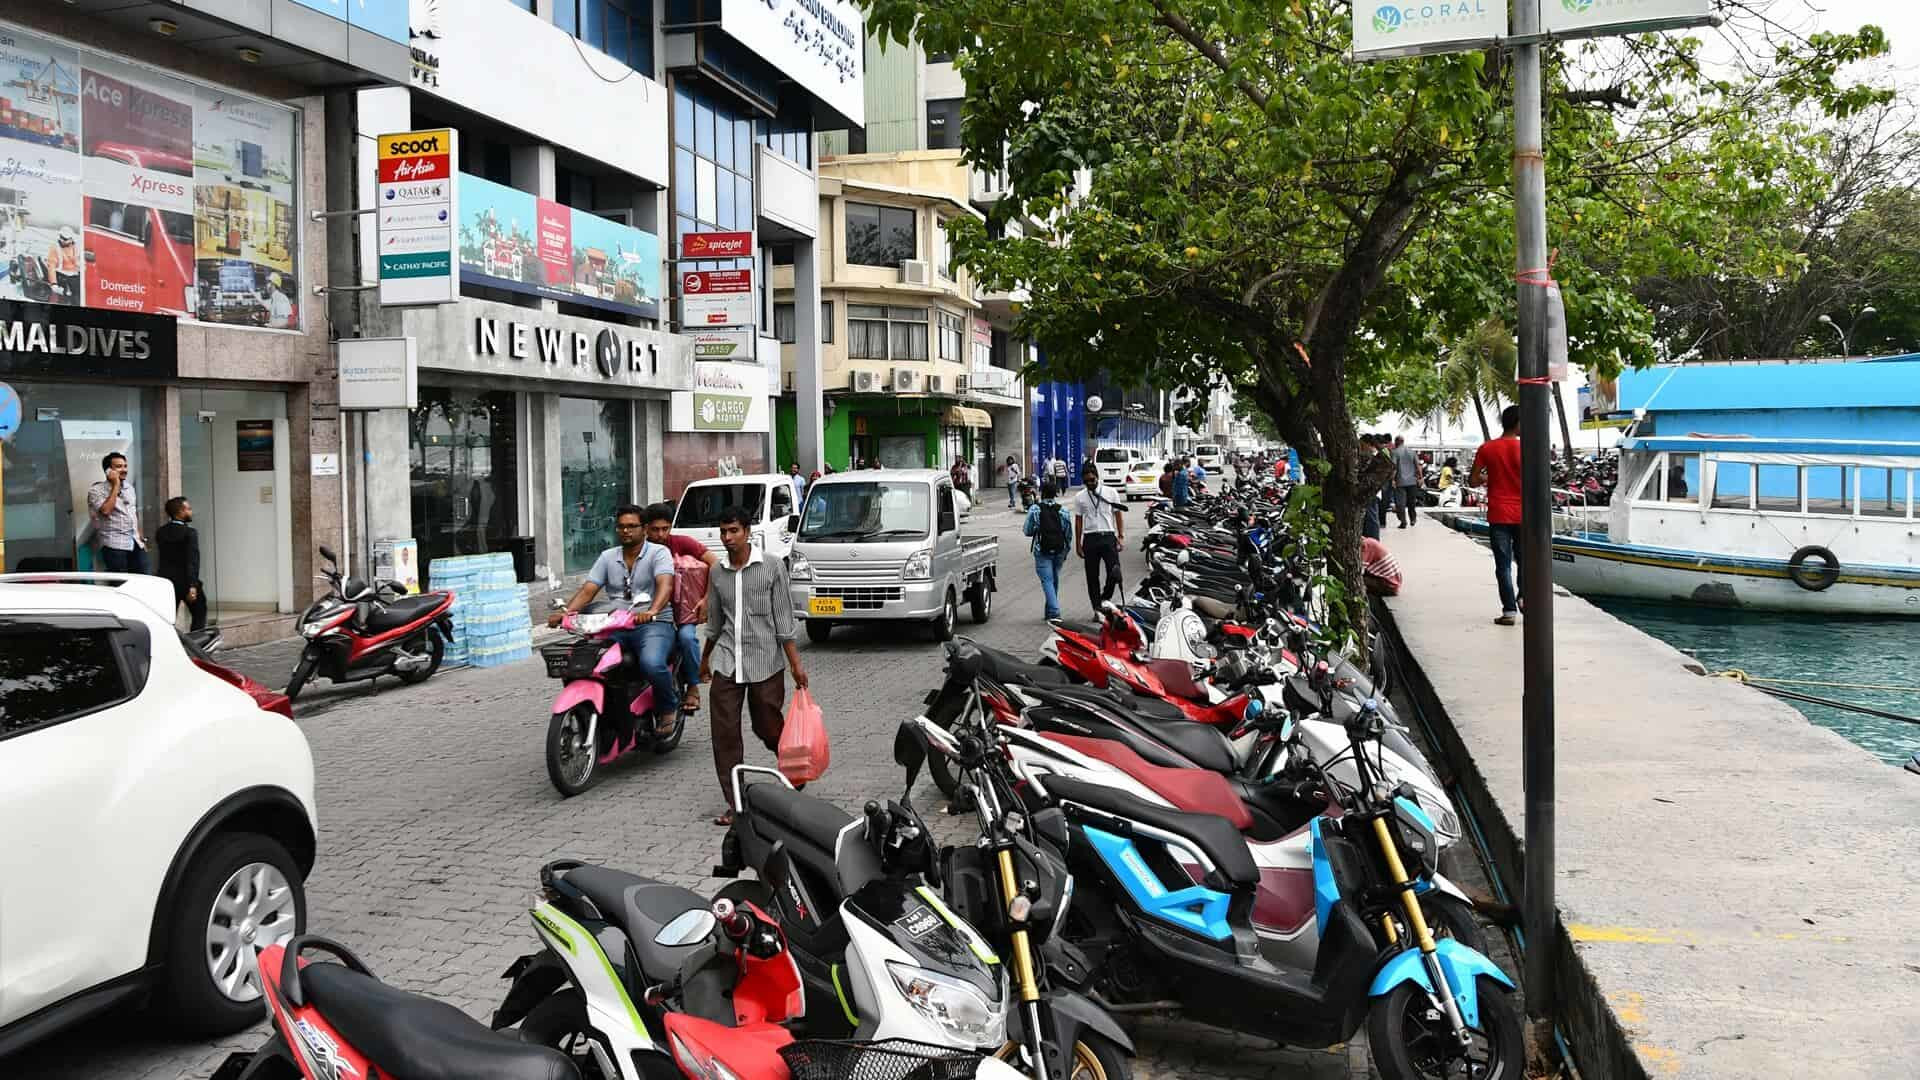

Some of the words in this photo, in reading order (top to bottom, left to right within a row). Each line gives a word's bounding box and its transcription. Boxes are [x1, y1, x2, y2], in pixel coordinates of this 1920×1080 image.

[1403, 0, 1486, 20] CORAL
[83, 75, 122, 106] Ace
[390, 136, 438, 155] scoot
[131, 174, 184, 196] Xpress
[399, 186, 430, 198] QATAR
[101, 279, 146, 295] Domestic
[106, 296, 144, 311] delivery
[0, 320, 150, 360] MALDIVES
[715, 400, 745, 413] CARGO
